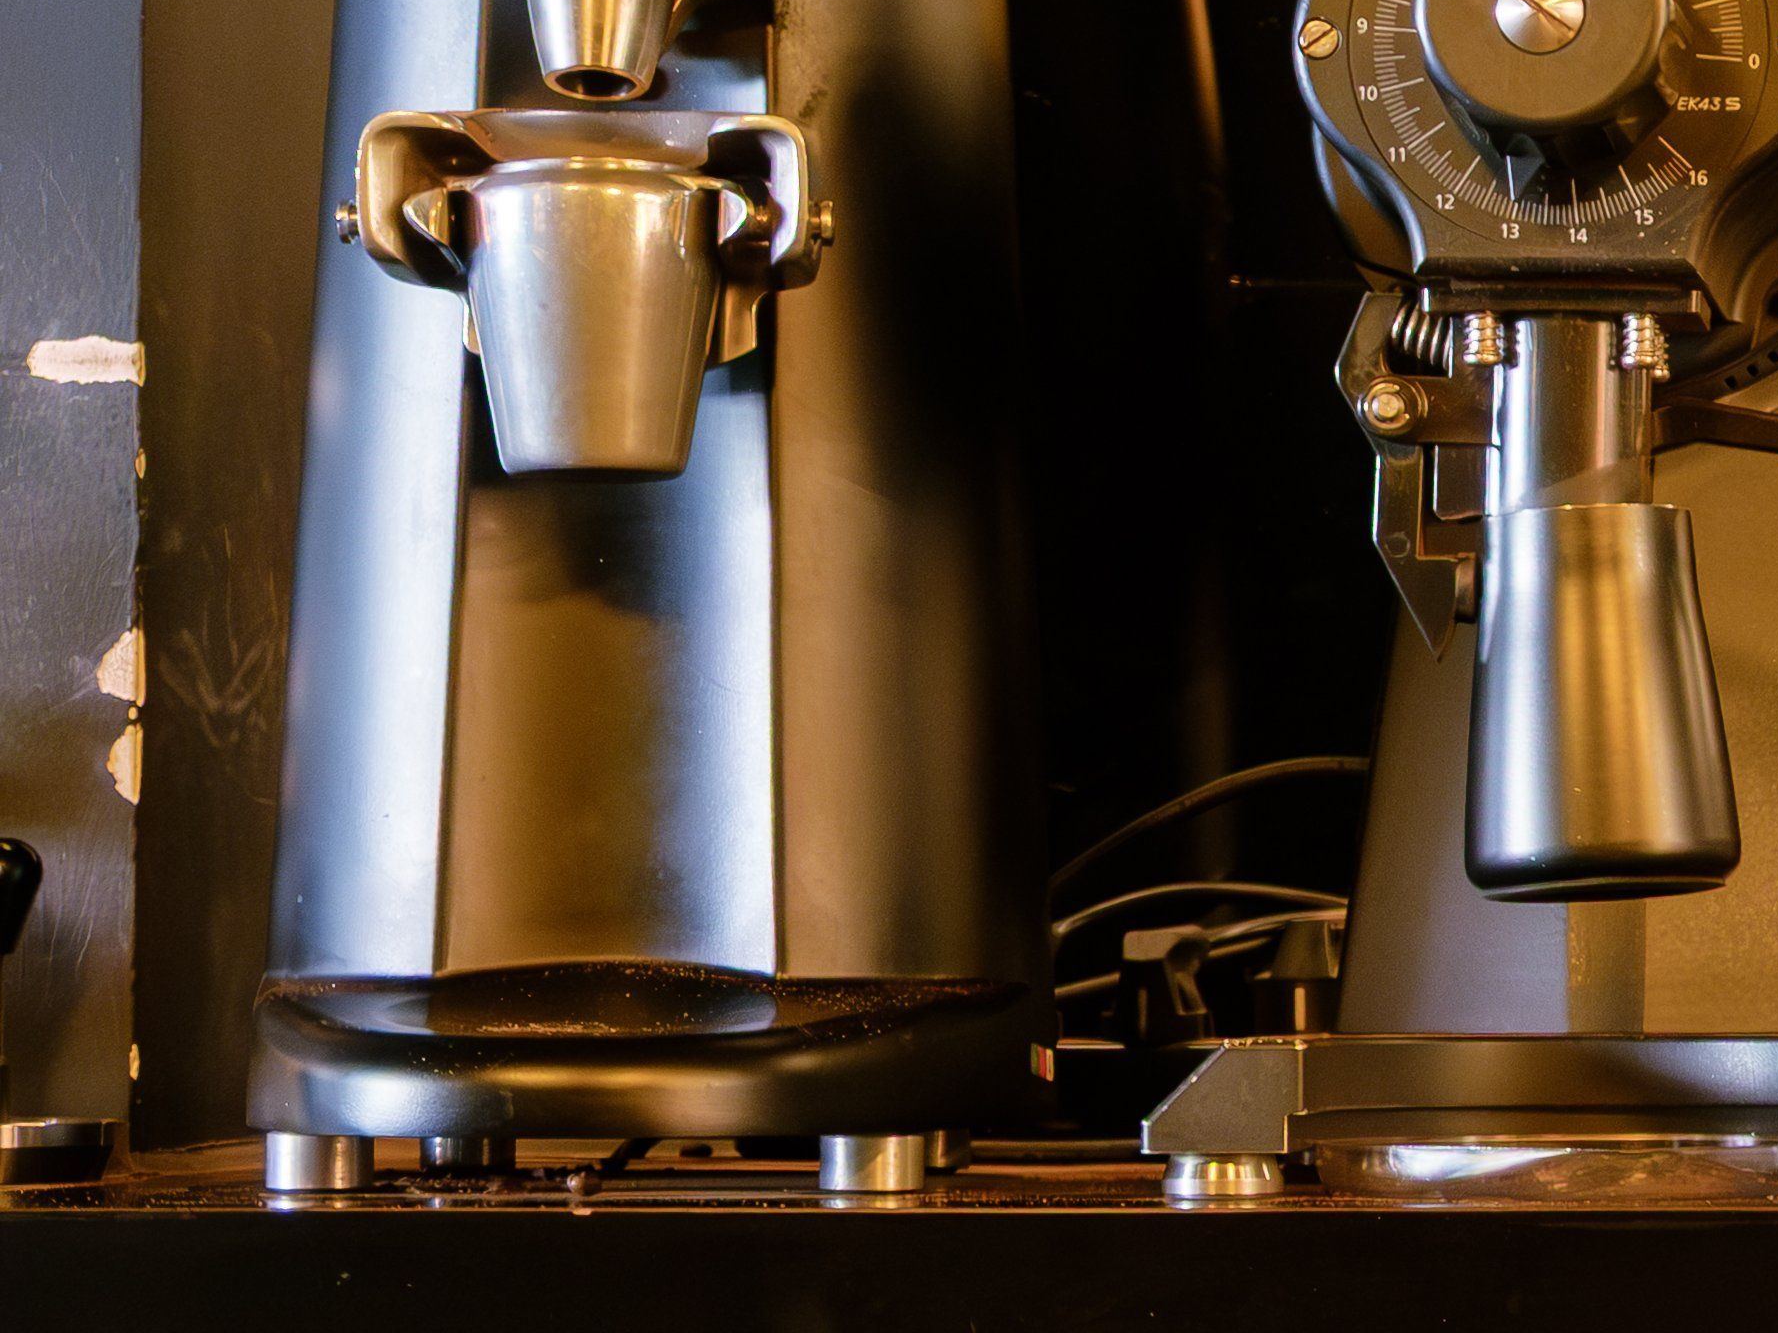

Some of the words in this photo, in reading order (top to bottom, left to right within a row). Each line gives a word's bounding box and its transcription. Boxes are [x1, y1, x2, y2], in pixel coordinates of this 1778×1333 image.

[1356, 18, 1368, 33] 9
[1748, 53, 1760, 69] 0
[1358, 86, 1378, 101] 10
[1676, 97, 1722, 111] EK43
[1725, 97, 1742, 110] S
[1388, 148, 1407, 163] 11
[1689, 170, 1708, 186] 16
[1435, 194, 1455, 210] 12
[1634, 208, 1654, 225] 15
[1500, 223, 1519, 239] 13
[1568, 228, 1588, 244] 14
